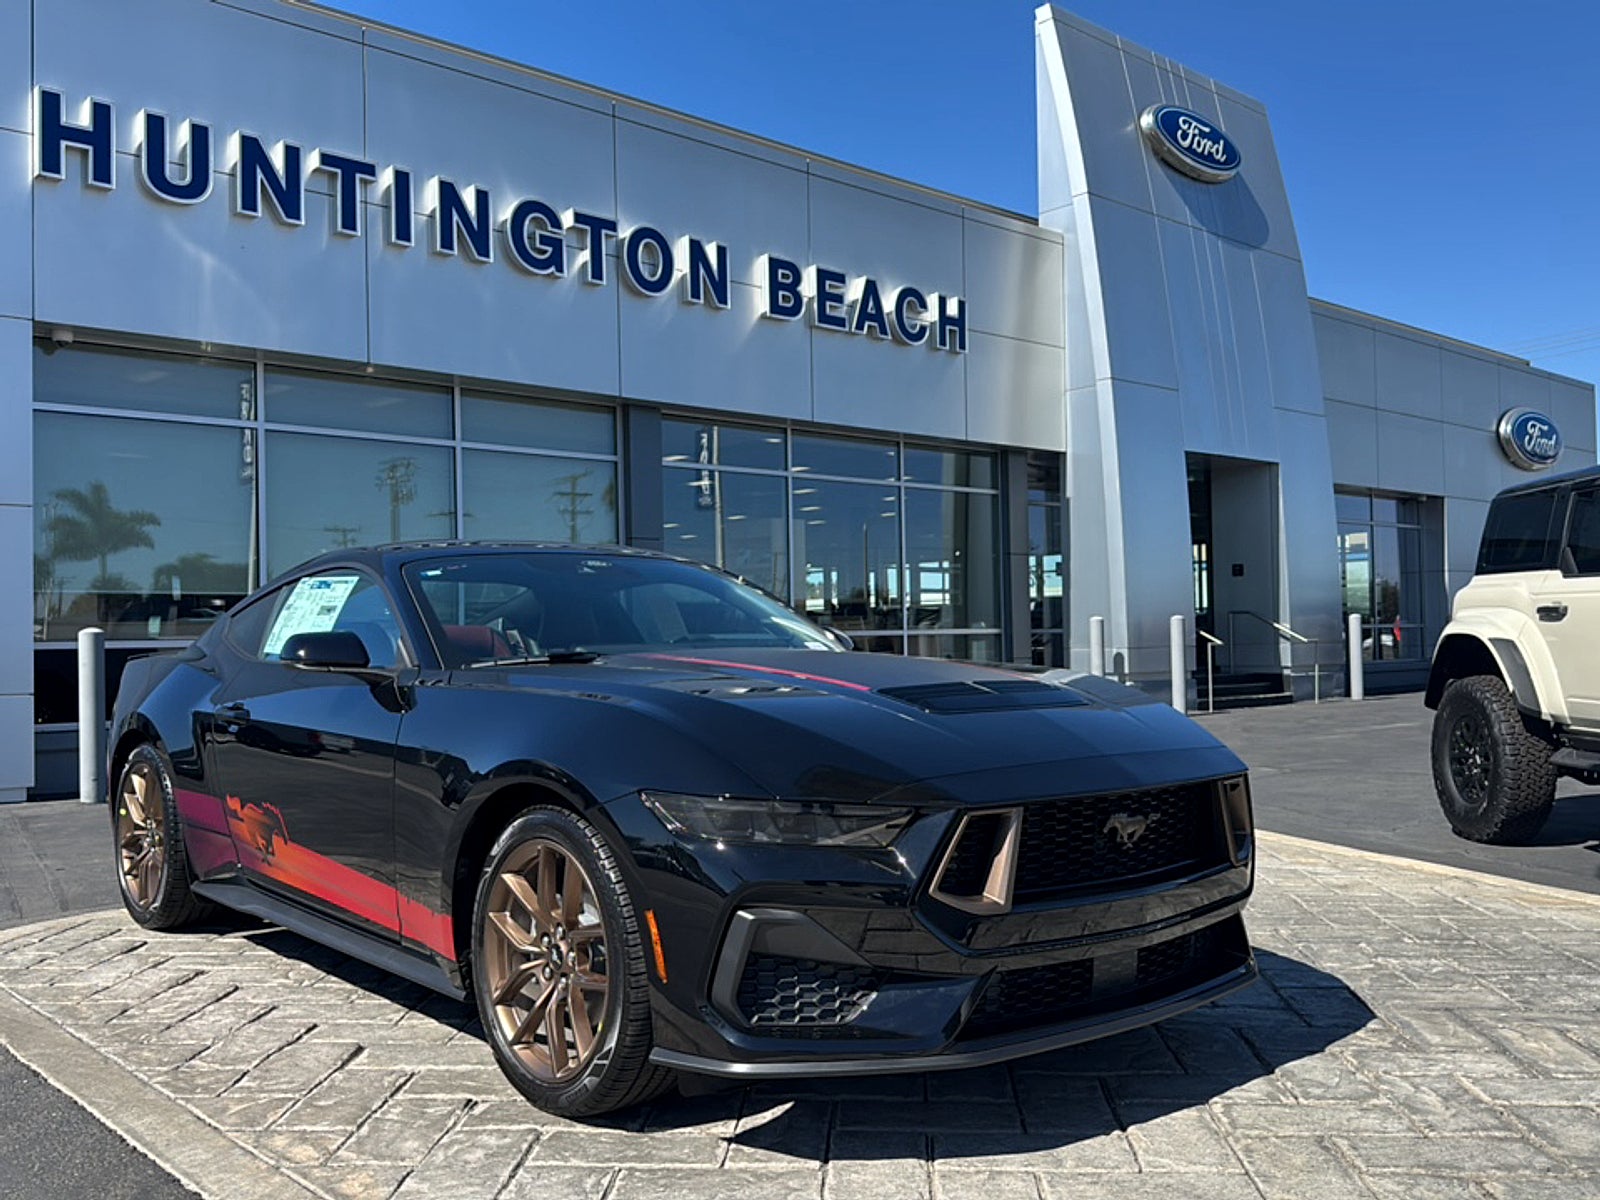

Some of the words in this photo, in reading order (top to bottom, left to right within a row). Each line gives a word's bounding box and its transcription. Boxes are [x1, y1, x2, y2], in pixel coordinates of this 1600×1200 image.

[1176, 115, 1227, 162] Ford
[34, 85, 731, 310] HUNTINGTON
[764, 254, 968, 354] BEACH
[1524, 420, 1558, 457] Ford
